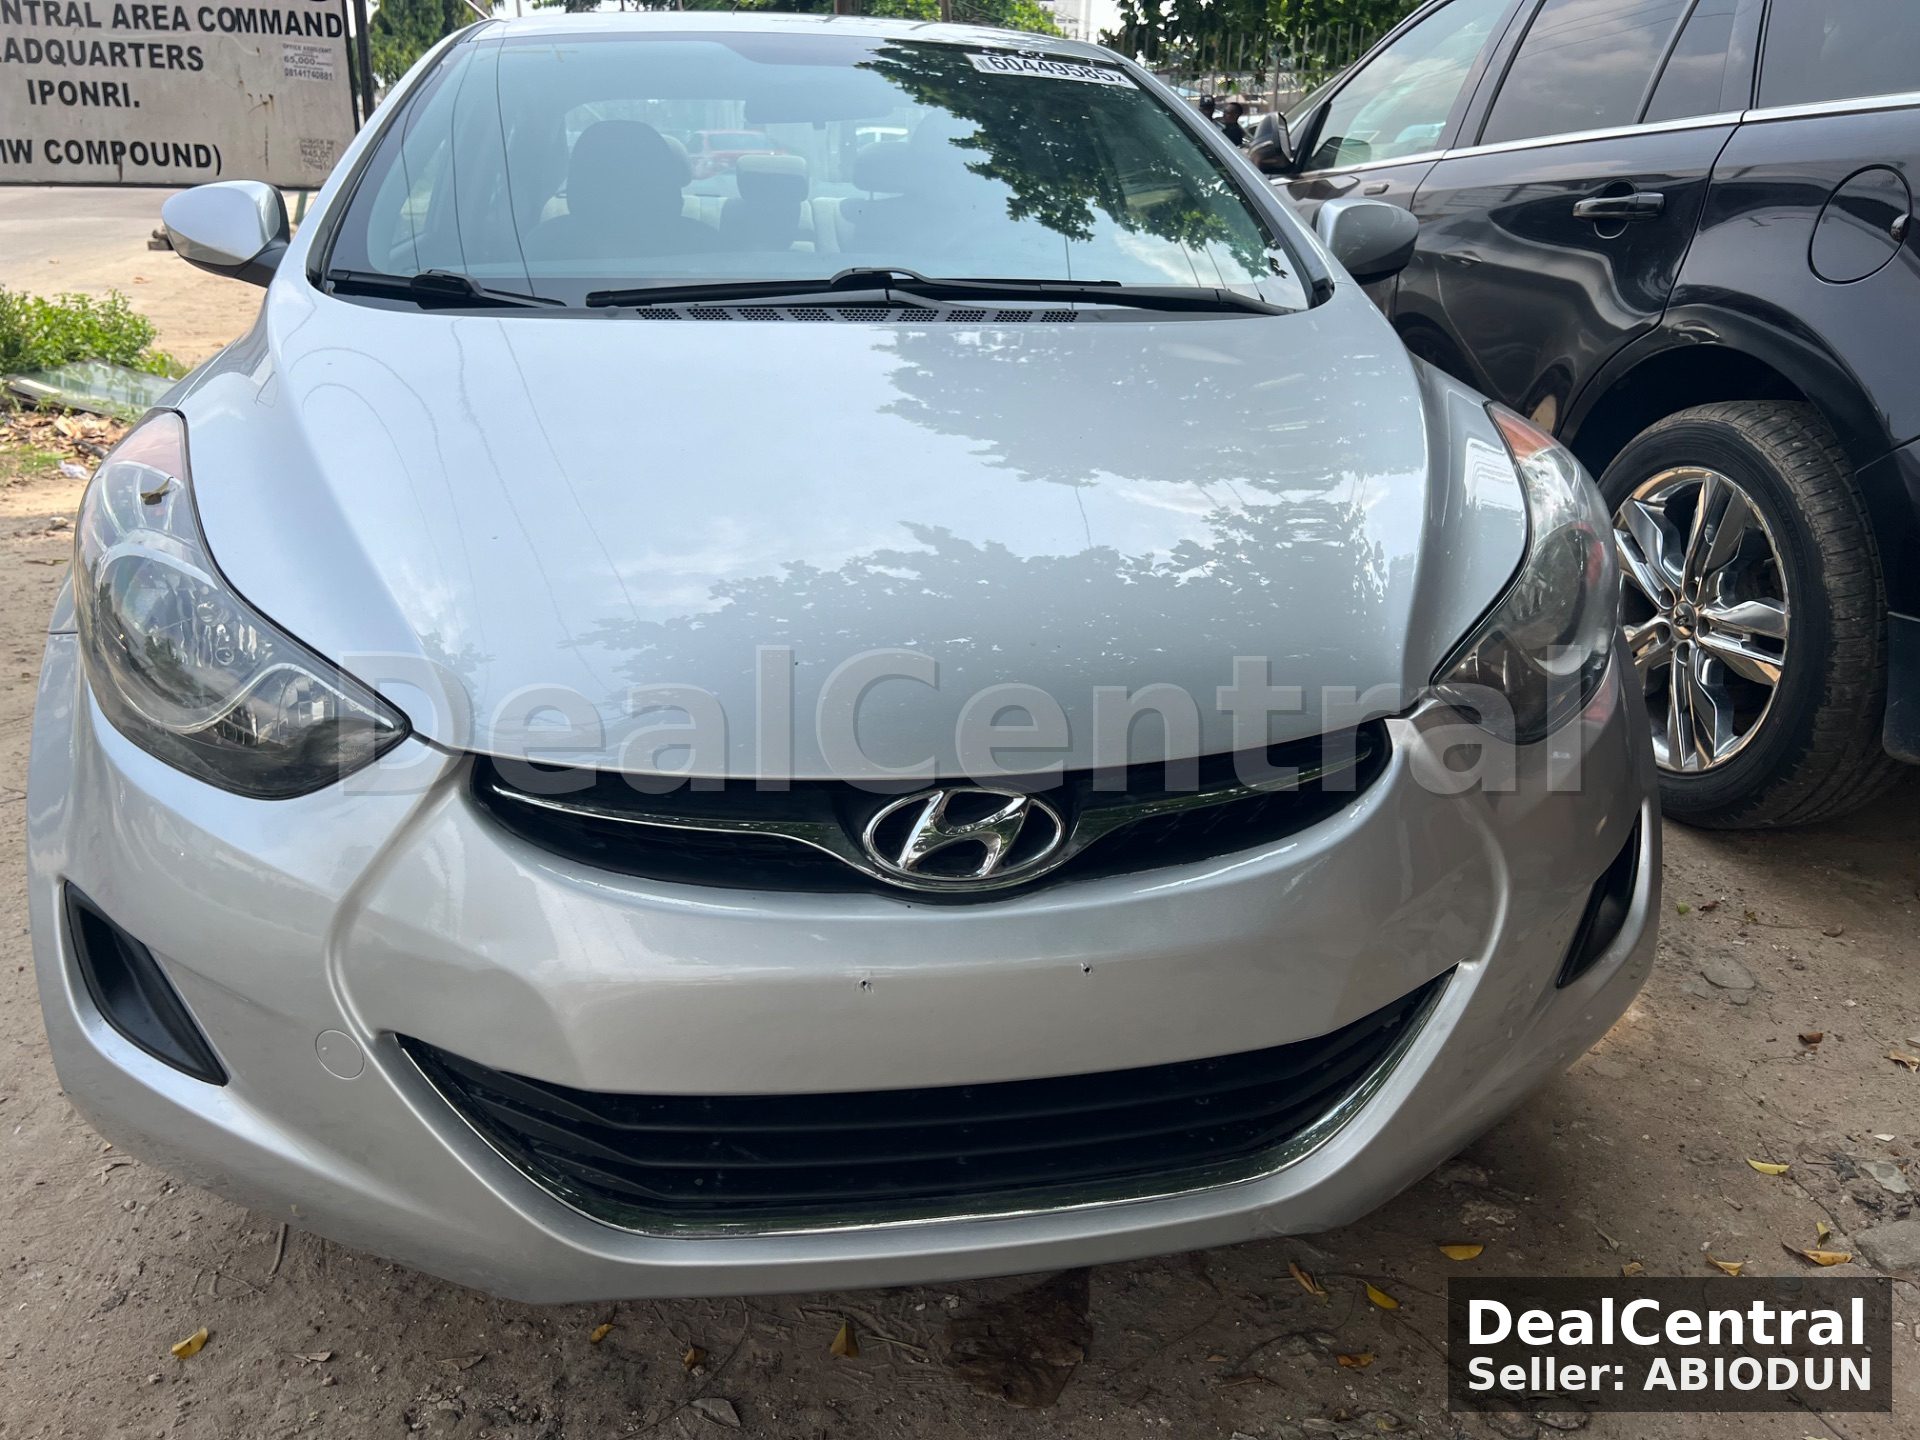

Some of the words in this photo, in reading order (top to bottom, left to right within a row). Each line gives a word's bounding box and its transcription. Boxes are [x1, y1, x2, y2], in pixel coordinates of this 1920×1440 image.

[0, 0, 102, 29] NTRAL
[112, 4, 191, 32] AREA
[198, 7, 343, 38] COMMAND
[0, 37, 204, 72] ADQUARTERS
[283, 55, 316, 66] 65,000
[27, 79, 140, 109] IPONRI.
[44, 139, 222, 176] COMPOUND)
